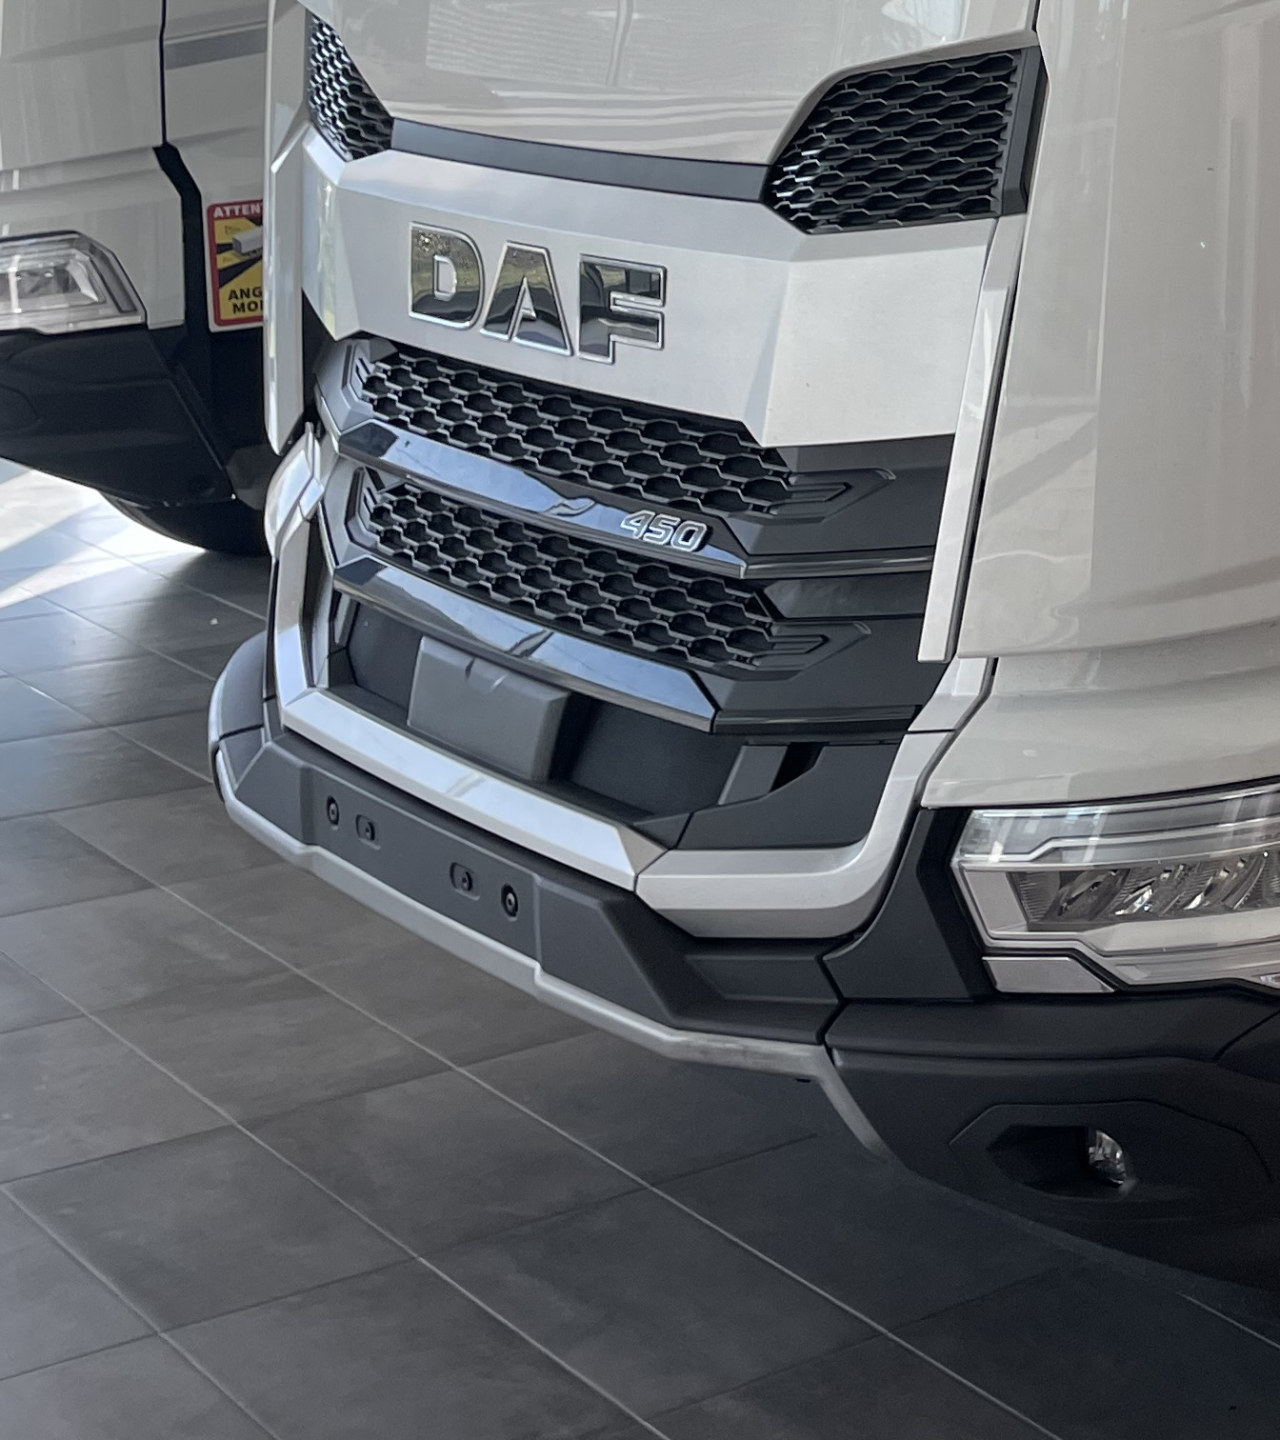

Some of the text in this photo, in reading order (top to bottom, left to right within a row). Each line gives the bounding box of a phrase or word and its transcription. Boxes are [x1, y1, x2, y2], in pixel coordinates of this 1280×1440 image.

[213, 203, 263, 219] ATTEN
[228, 286, 263, 301] ANG
[408, 221, 668, 365] DAF
[620, 509, 708, 553] 450
